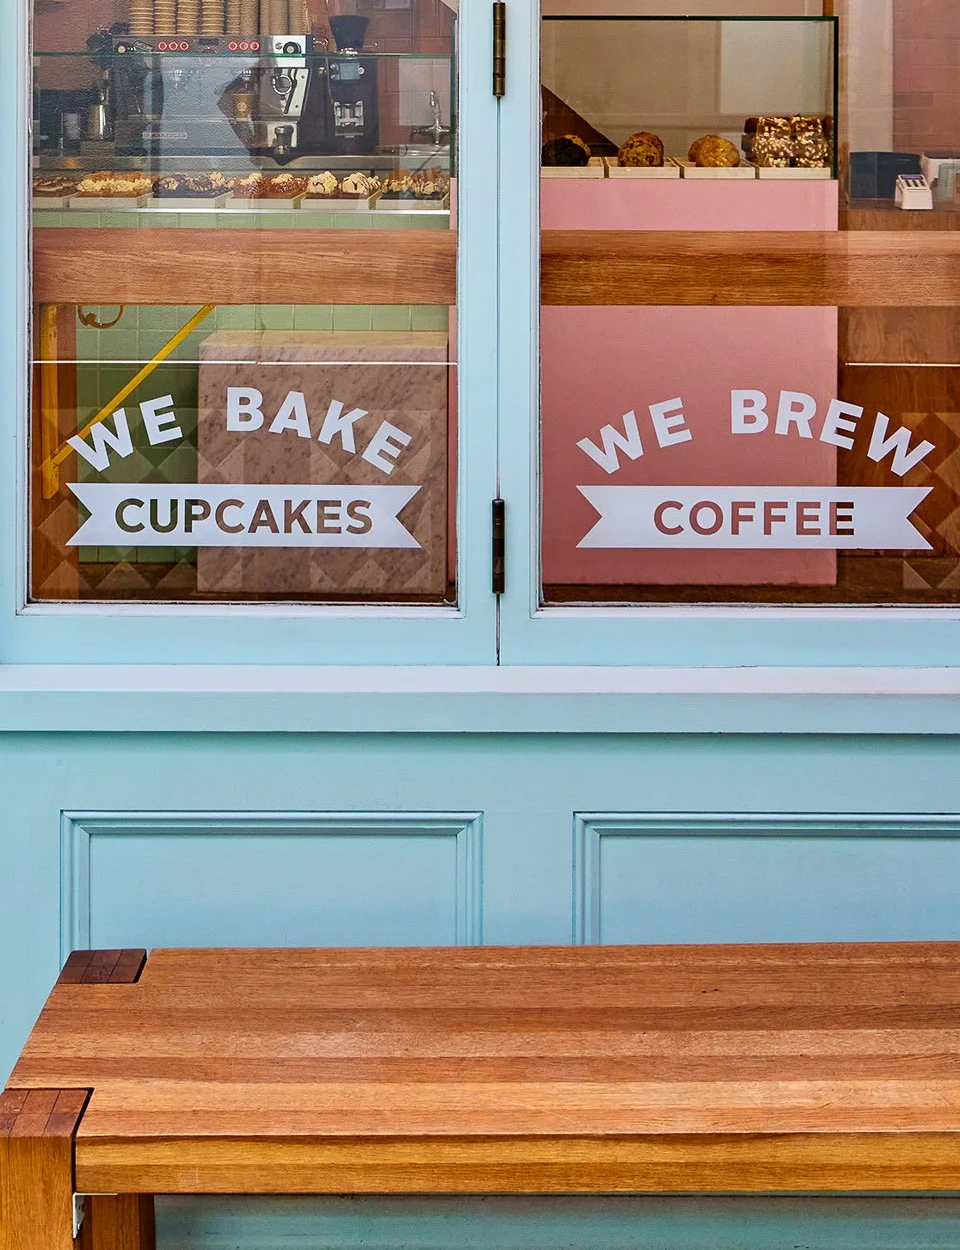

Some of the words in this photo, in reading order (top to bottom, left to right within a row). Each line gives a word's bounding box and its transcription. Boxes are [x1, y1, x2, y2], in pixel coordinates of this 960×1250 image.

[66, 394, 183, 472] WE
[226, 386, 412, 475] BAKE
[576, 397, 693, 475] WE
[730, 389, 935, 477] BREW
[114, 497, 373, 535] CUPCAKES
[653, 500, 855, 536] COFFEE
